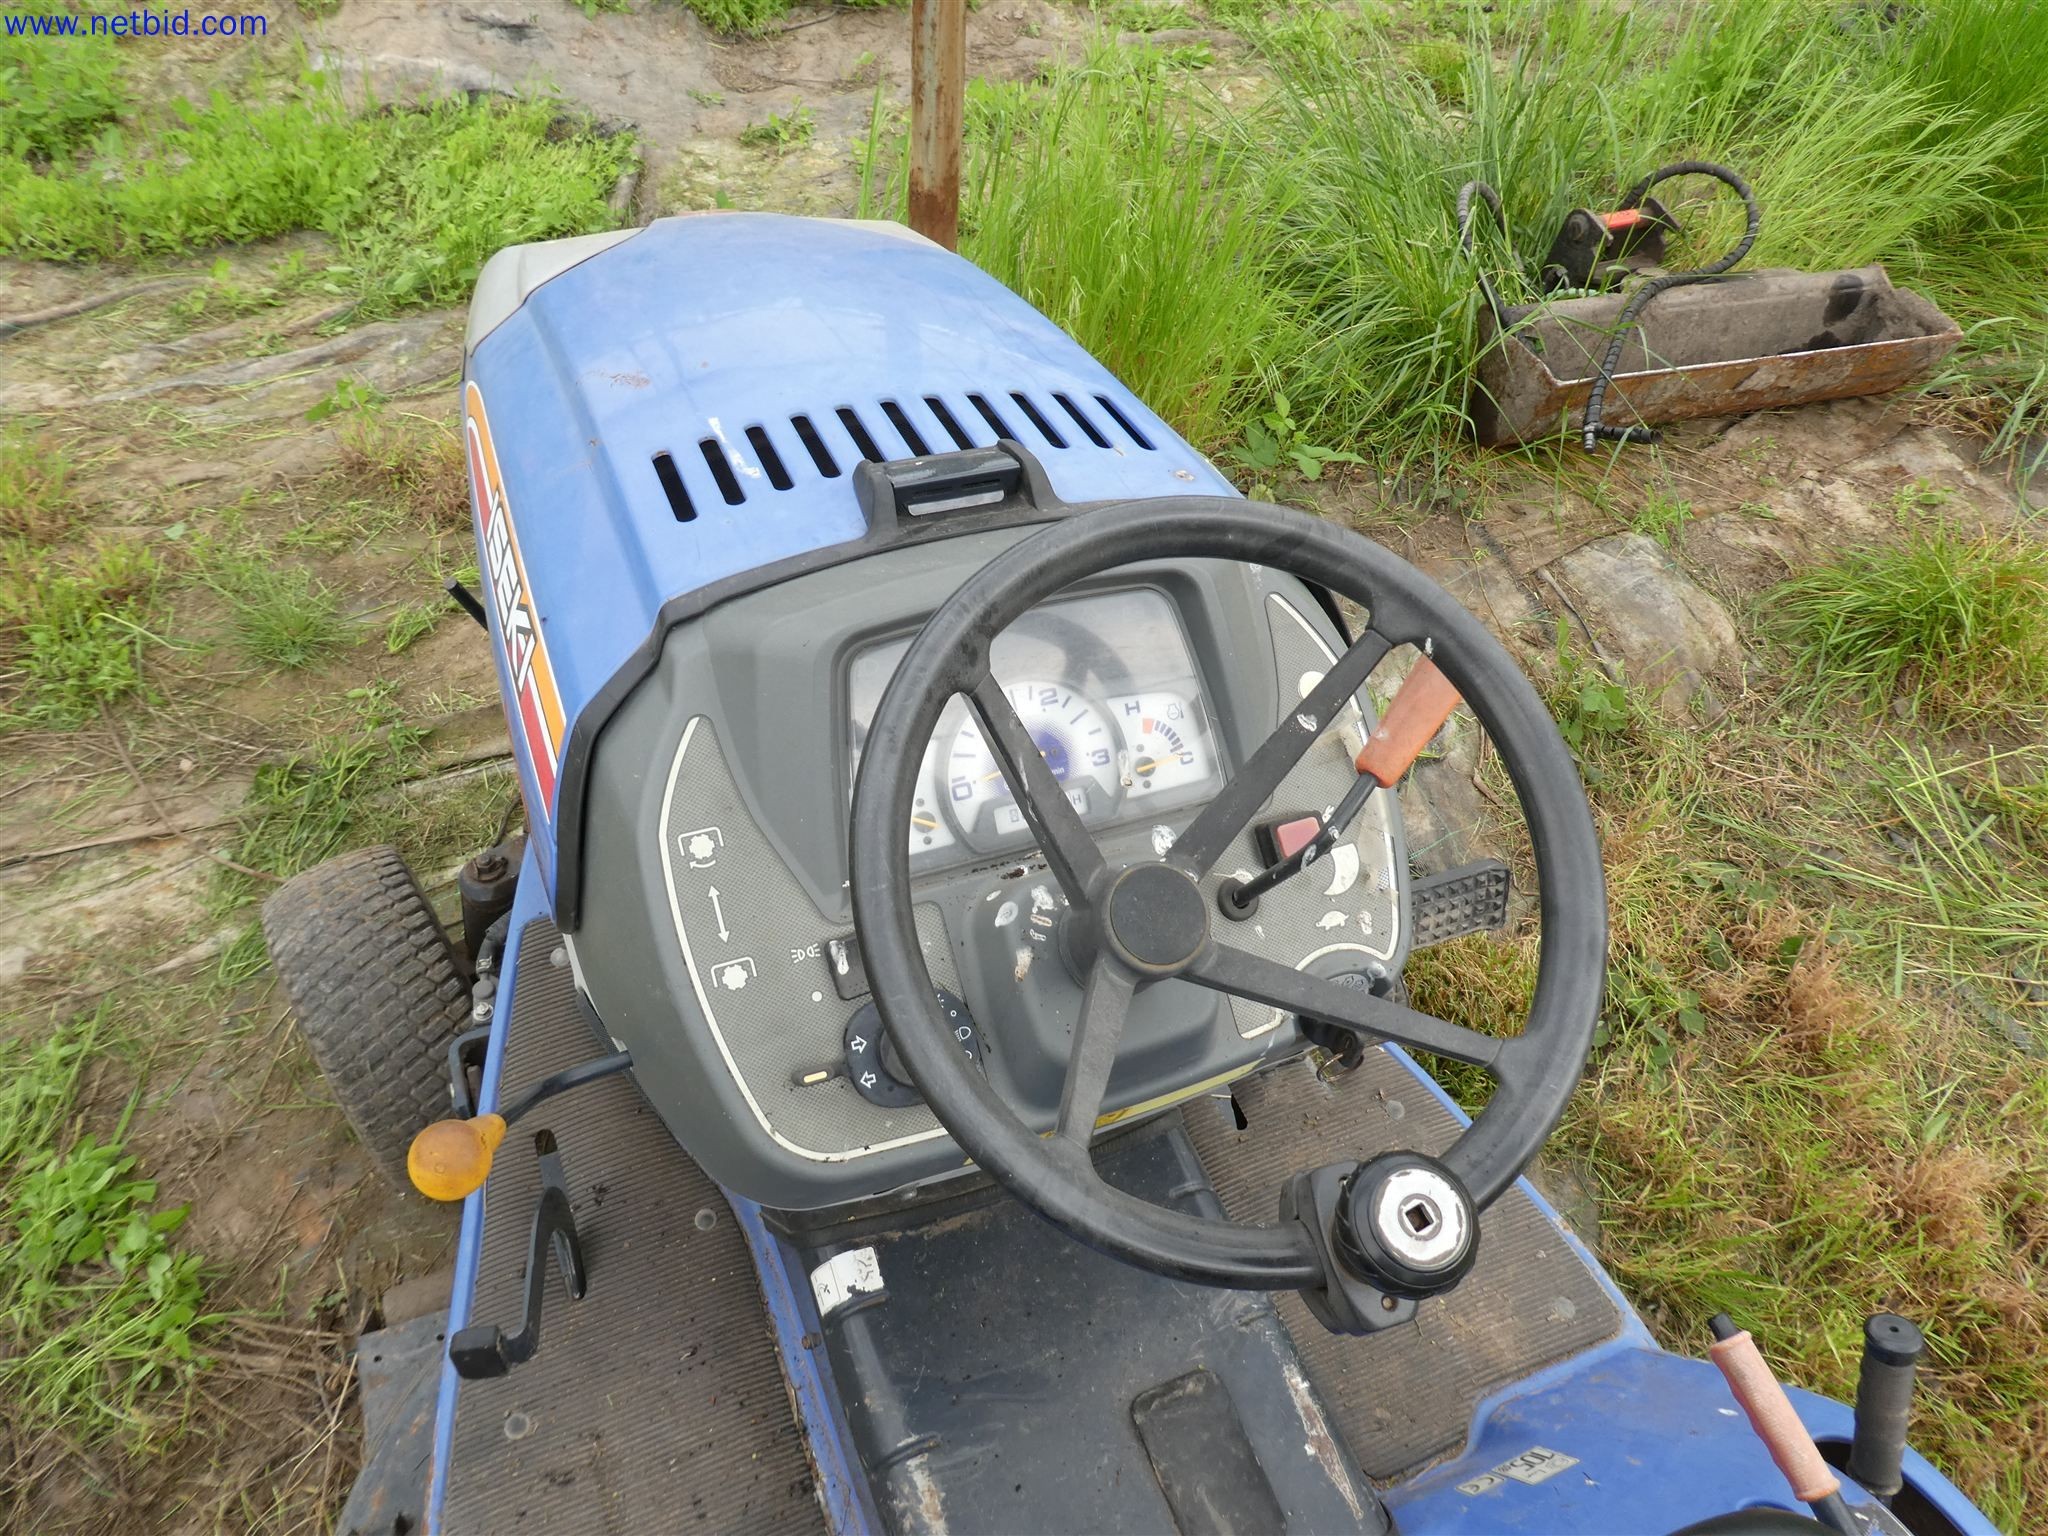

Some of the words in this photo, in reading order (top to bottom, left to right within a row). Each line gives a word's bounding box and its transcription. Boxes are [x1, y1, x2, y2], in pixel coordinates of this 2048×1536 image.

[486, 484, 537, 693] ISEKI
[1038, 687, 1058, 706] 2
[1124, 700, 1141, 716] H
[1091, 748, 1110, 767] 3
